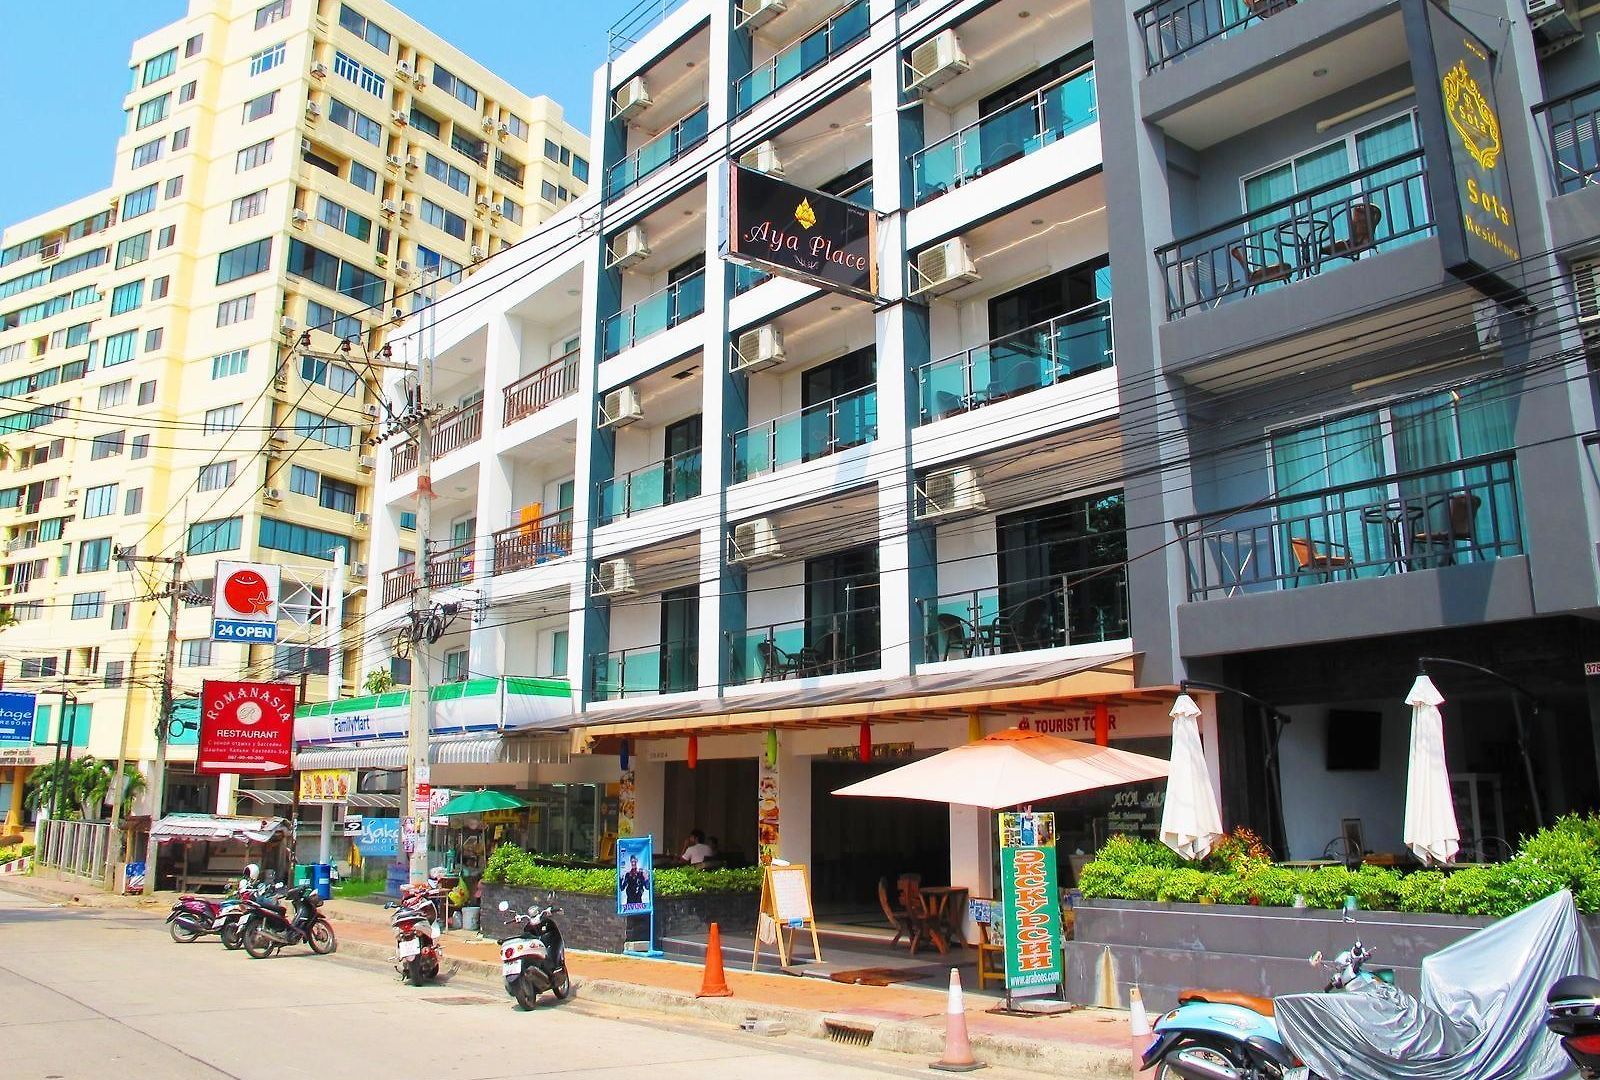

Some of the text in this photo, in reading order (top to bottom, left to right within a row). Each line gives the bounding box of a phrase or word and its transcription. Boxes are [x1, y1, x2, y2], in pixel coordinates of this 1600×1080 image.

[1467, 179, 1509, 226] Sota
[744, 221, 866, 271] Aya Place
[218, 624, 273, 638] 24 OPEN
[206, 687, 291, 723] ROMANASIA
[216, 729, 279, 739] RESTAURANT
[334, 715, 370, 735] FamilyMart
[1034, 714, 1117, 734] TOURIST TOR
